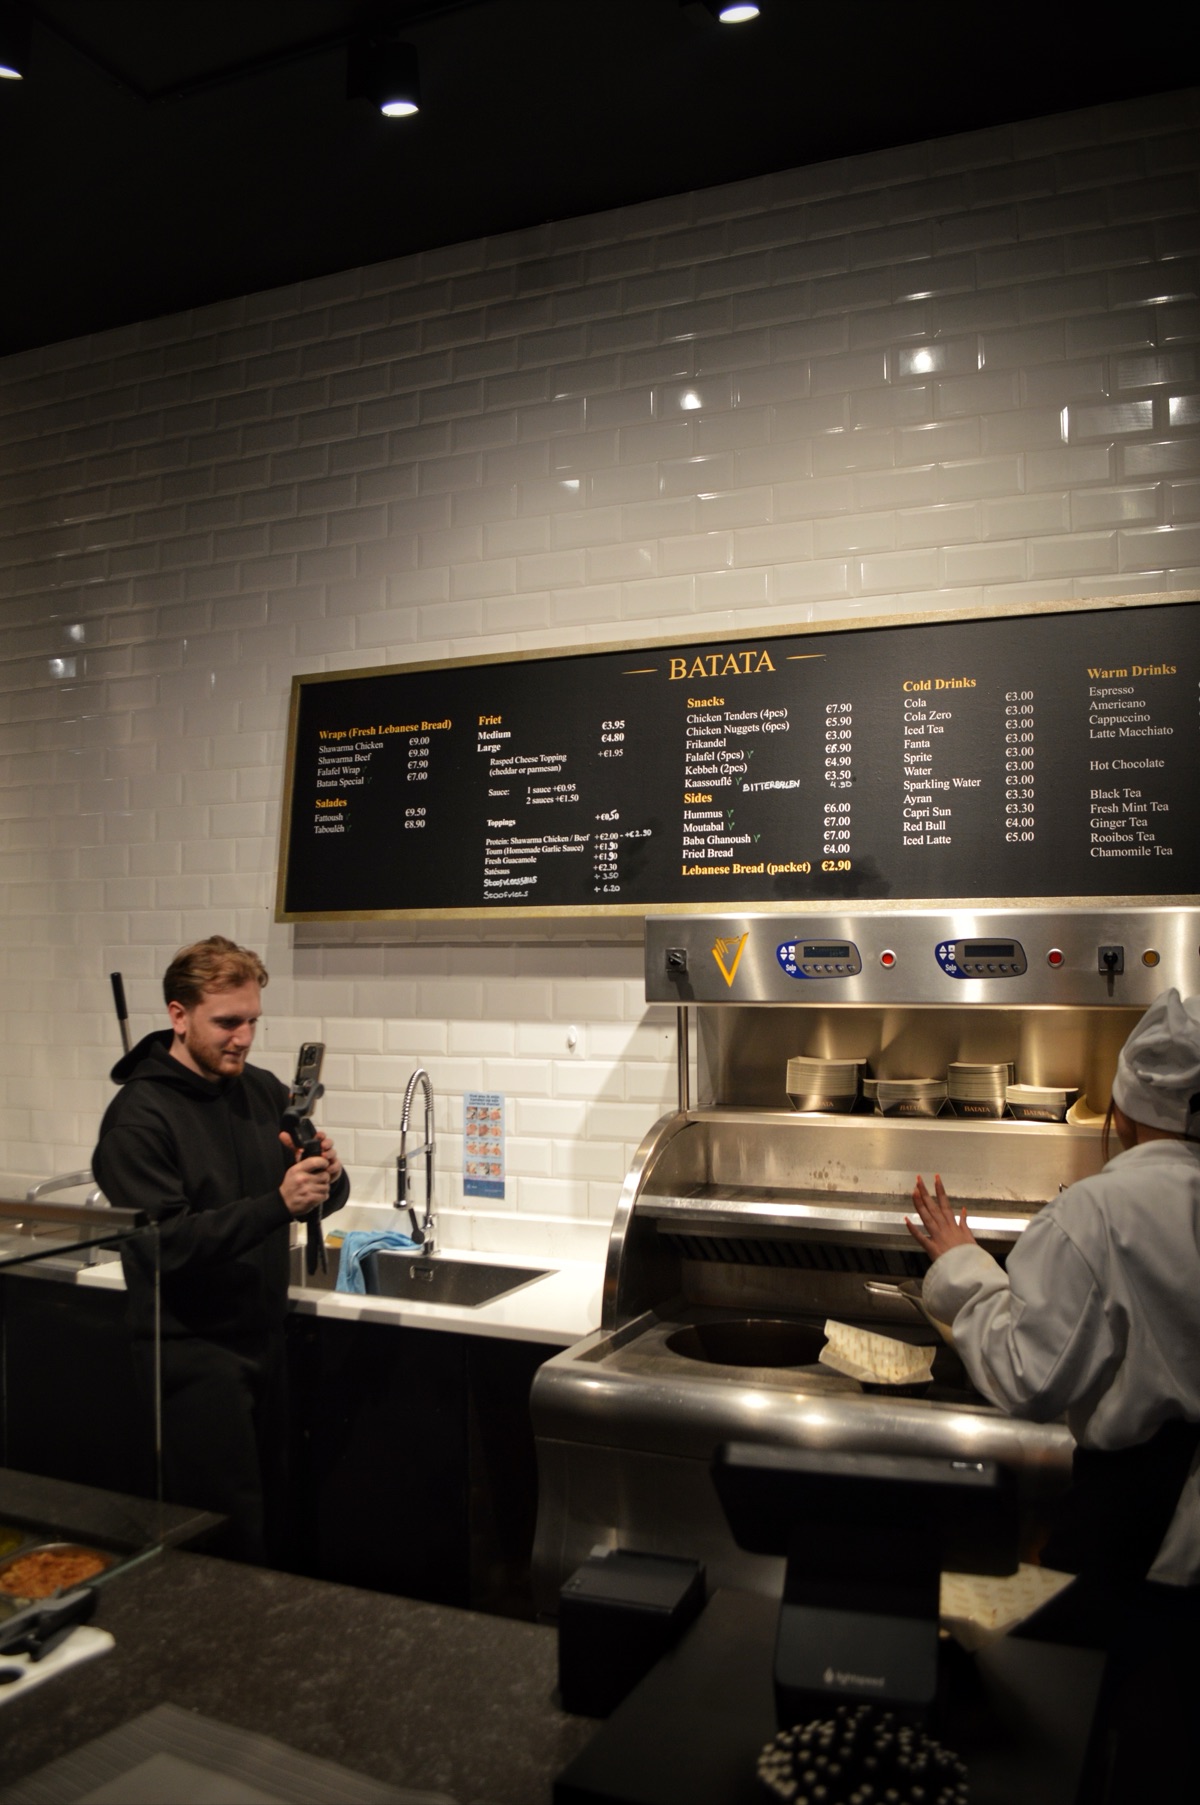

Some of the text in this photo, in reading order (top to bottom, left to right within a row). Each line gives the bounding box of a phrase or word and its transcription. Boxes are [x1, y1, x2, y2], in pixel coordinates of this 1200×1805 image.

[668, 650, 776, 680] BATATA
[1087, 664, 1177, 680] Warm Drinks
[903, 677, 977, 692] Cold Drinks
[1089, 686, 1134, 698] Espresso
[687, 696, 725, 709] Snacks
[904, 691, 1033, 708] Cola €3.00
[1089, 700, 1146, 711] Americano
[478, 715, 502, 725] Friet
[686, 703, 852, 724] Chicken Tenders (4pcs) €7.90
[904, 705, 1034, 722] Cola Zero €3.00
[1089, 713, 1151, 726] Cappuccino
[319, 719, 452, 740] Wraps (Fresh Lebanese Bread)
[478, 720, 625, 740] Medium €3.95
[686, 716, 852, 737] Chicken Nuggets (6pcs) €5.90
[904, 719, 1034, 735] Iced Tea €3.00
[1089, 726, 1173, 739] Latte Macchiato
[319, 737, 430, 753] Shawarma Chicken €9.00
[477, 733, 625, 753] Large €4.80
[686, 730, 852, 750] Frikandel €3.00
[904, 733, 1034, 749] Fanta €3.00
[318, 748, 429, 765] Shawarma Beef €9.80
[490, 757, 514, 766] Rasped
[514, 755, 538, 764] Cheese
[539, 753, 567, 764] Topping
[685, 752, 715, 762] Falafel
[717, 750, 744, 761] (5pcs)
[904, 747, 1034, 765] Sprite €3.00
[317, 760, 428, 776] Falafel Wrap €7.90
[489, 767, 517, 777] (cheddar
[527, 764, 561, 775] parmesan)
[685, 757, 851, 775] Kebbeh (2pcs) €4.90
[904, 761, 1034, 776] Water €3.00
[1090, 758, 1164, 771] Hot Chocolate
[316, 772, 428, 787] Batata Special €7.00
[684, 770, 851, 788] Kaassouflé €3.50
[903, 775, 1034, 792] Sparkling Water €3.00
[488, 788, 510, 796] Sauce:
[532, 786, 551, 794] sauce
[684, 793, 713, 804] Sides
[903, 789, 1034, 806] Ayran €3.30
[1090, 788, 1141, 799] Black Tea
[315, 798, 347, 808] Salades
[526, 797, 531, 805] 2
[532, 796, 554, 804] sauces
[1090, 802, 1169, 814] Fresh Mint Tea
[405, 808, 426, 817] €9.50
[684, 803, 851, 820] Hummus €6.00
[903, 803, 1034, 819] Capri Sun €3.30
[404, 820, 425, 829] €8.90
[487, 819, 516, 828] Toppings
[683, 816, 850, 833] Moutabal €7.00
[903, 817, 1034, 832] Red Bull €4.00
[1090, 817, 1148, 830] Ginger Tea
[510, 836, 542, 844] Shawarma
[543, 835, 569, 843] Chicken
[683, 830, 850, 846] Baba Ghanoush €7.00
[903, 832, 1034, 845] Iced Latte €5.00
[1091, 831, 1155, 843] Rooibos Tea
[503, 845, 541, 854] (Homemade
[542, 844, 561, 852] Garlic
[562, 844, 584, 852] Sauce)
[682, 844, 850, 859] Fried Bread €4.00
[1090, 846, 1173, 857] Chamomile Tea
[485, 856, 502, 865] Fresh
[503, 856, 537, 864] Guacamole
[682, 860, 851, 876] Lebanese Bread (packet) €2.90
[964, 1105, 991, 1113] BATATA
